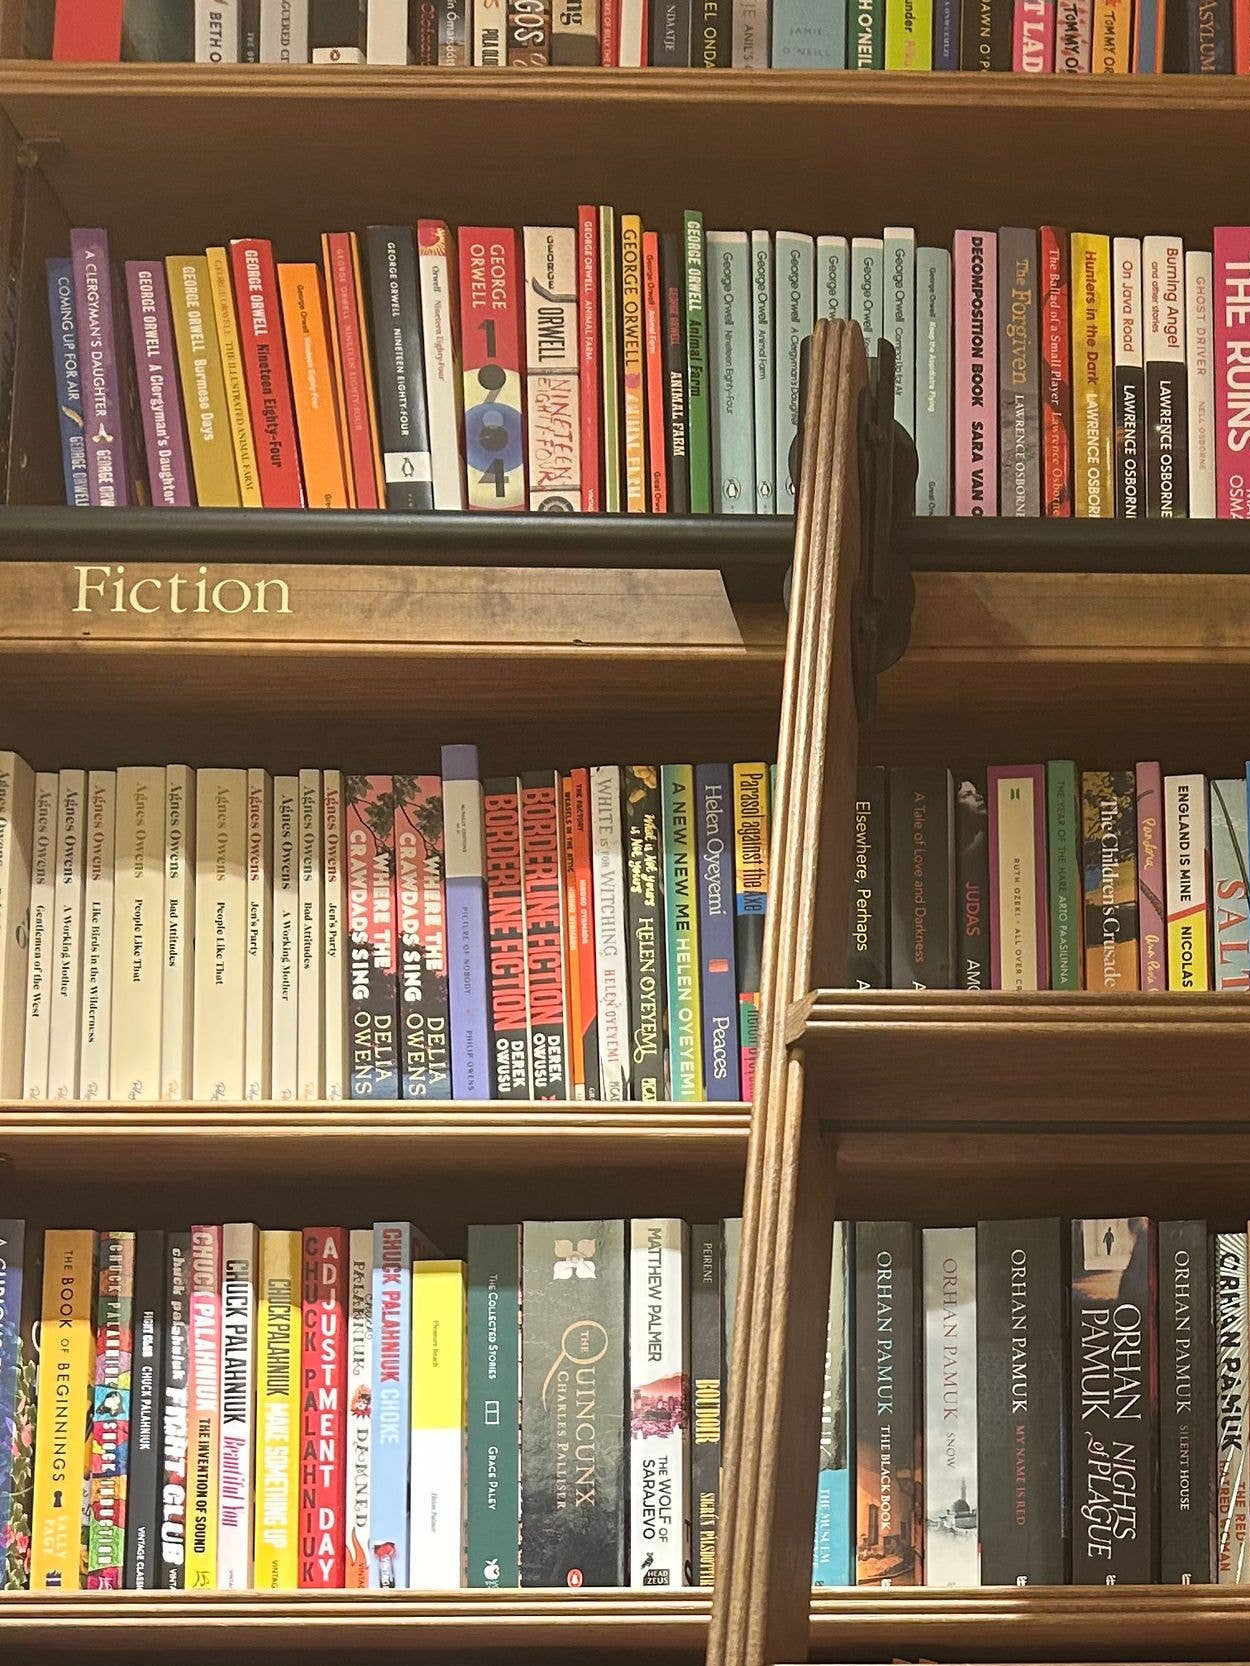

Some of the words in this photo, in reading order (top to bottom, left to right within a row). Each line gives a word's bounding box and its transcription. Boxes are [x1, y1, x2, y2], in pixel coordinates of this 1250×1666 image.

[387, 242, 398, 278] GEORGE
[469, 244, 486, 308] ORWELL
[490, 244, 506, 310] GEORGE
[1122, 260, 1132, 278] On
[1164, 248, 1179, 302] Burning
[390, 282, 400, 317] ORWELL
[1122, 282, 1132, 311] Java
[538, 307, 564, 362] ORWELL
[1123, 316, 1134, 352] Road
[1164, 305, 1180, 348] Angel
[72, 566, 292, 613] Fiction
[672, 783, 683, 794] A
[673, 802, 687, 844] NEW
[855, 801, 871, 883] Elsewhere,
[350, 832, 368, 945] CRAWDADS
[674, 853, 688, 896] NEW
[676, 905, 689, 930] ME
[854, 889, 871, 951] Perhaps
[352, 949, 369, 1000] SING
[678, 938, 691, 998] HELEN
[354, 1012, 371, 1095] OWENS
[374, 1015, 392, 1083] DELIA
[679, 1007, 695, 1095] OYEYEMI
[712, 1017, 729, 1080] Peaces
[648, 1228, 661, 1299] MATTHEW
[61, 1278, 72, 1328] BOOK
[320, 1237, 337, 1487] ADJUSTMENT
[648, 1304, 661, 1362] PALMER
[1112, 1304, 1142, 1420] ORHAN
[1081, 1308, 1110, 1420] PAMUK
[53, 1362, 69, 1481] BEGINNINGS
[880, 1425, 890, 1449] THE
[880, 1453, 891, 1492] BLACK
[1112, 1441, 1137, 1543] NIGHTS
[880, 1492, 891, 1531] BOOK
[1083, 1457, 1112, 1560] PLAGUE
[319, 1507, 334, 1582] DAY
